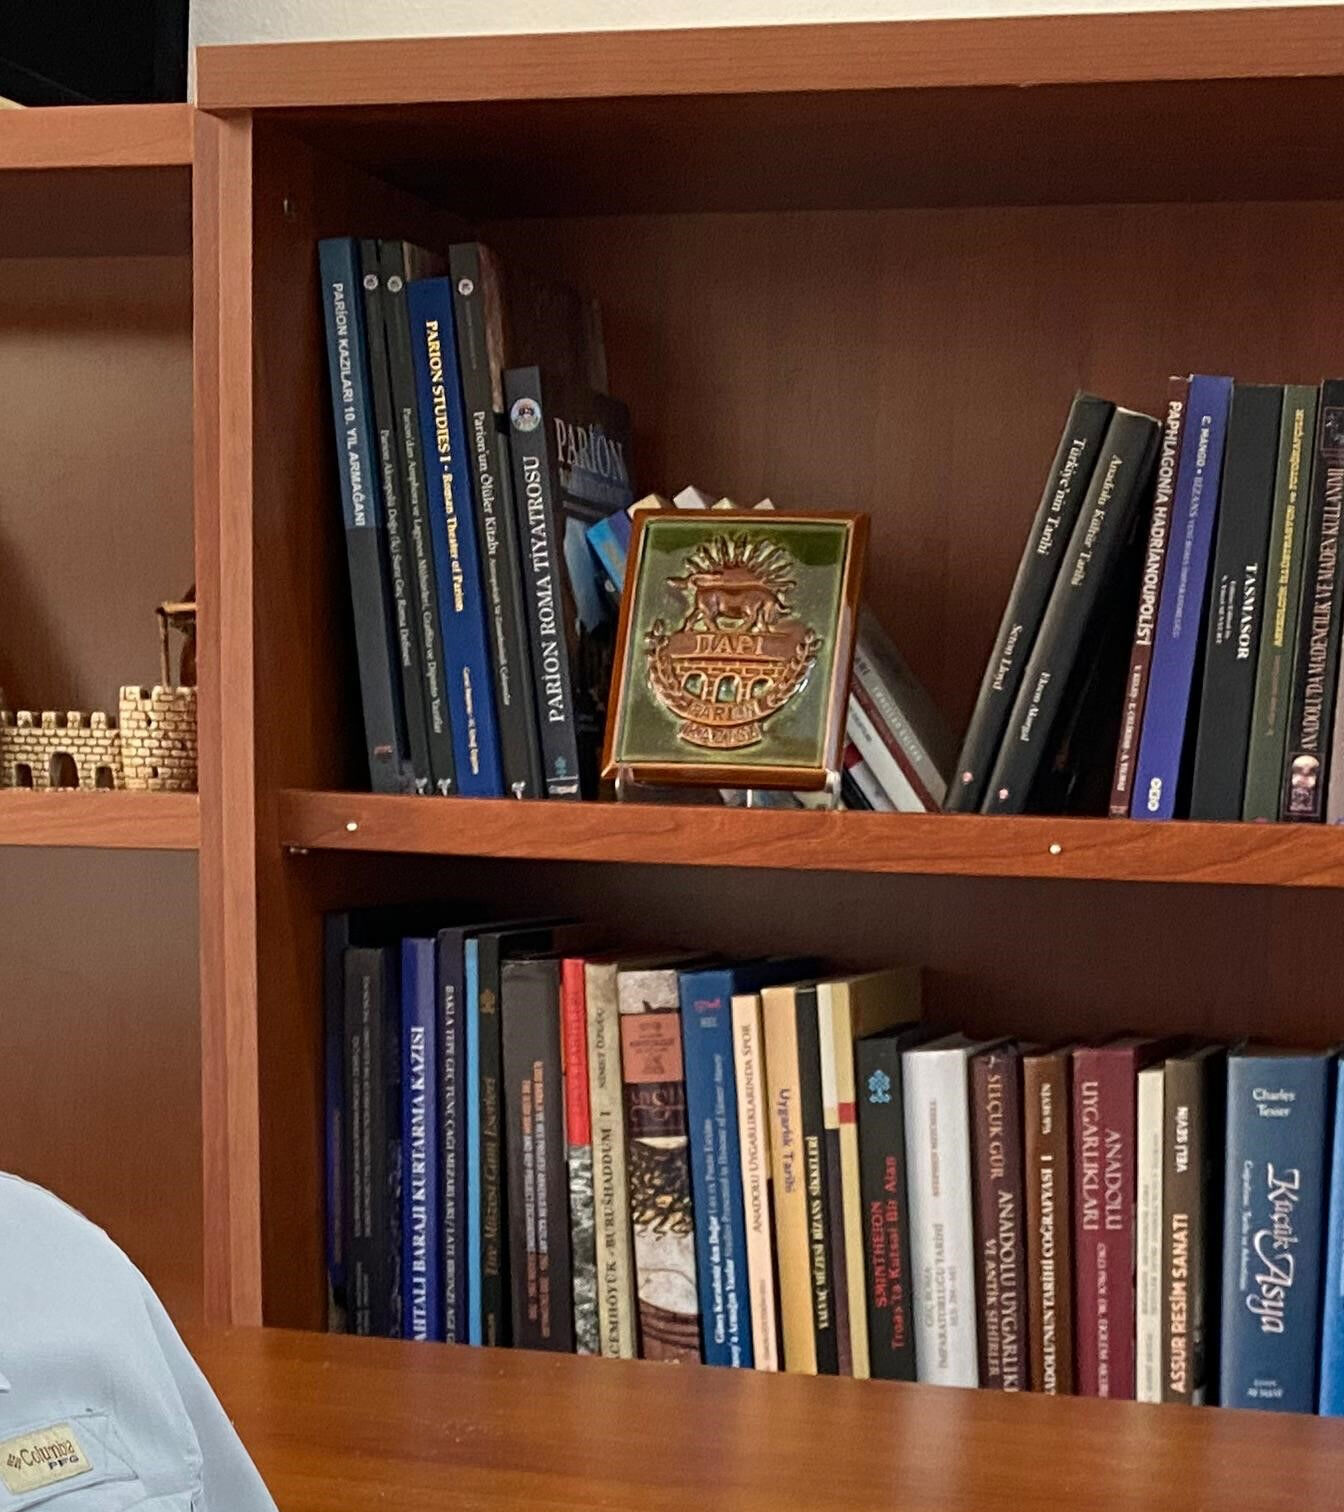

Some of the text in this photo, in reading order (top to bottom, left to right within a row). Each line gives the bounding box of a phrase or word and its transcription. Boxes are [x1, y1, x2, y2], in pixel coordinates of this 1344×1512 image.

[332, 282, 347, 335] PARİON
[425, 320, 442, 382] PARION
[338, 338, 353, 402] KAZILARI
[432, 385, 450, 452] STUDIES
[473, 411, 489, 471] Parion'un
[1037, 438, 1086, 554] Türkiye'nin Tarihi
[523, 456, 564, 721] PARİON ROMA TİYATROSU
[1318, 537, 1336, 579] MADEN
[1237, 563, 1257, 658] TASMASOR
[1252, 1086, 1296, 1103] Charles
[411, 1094, 425, 1200] KURTARMA
[1082, 1081, 1099, 1229] UYGARLIKLARI
[1104, 1129, 1122, 1229] ANADOLU
[998, 1190, 1015, 1285] ANADOLU
[1246, 1229, 1294, 1333] Asya
[1169, 1213, 1187, 1392] ASSUR RESİM SANATI
